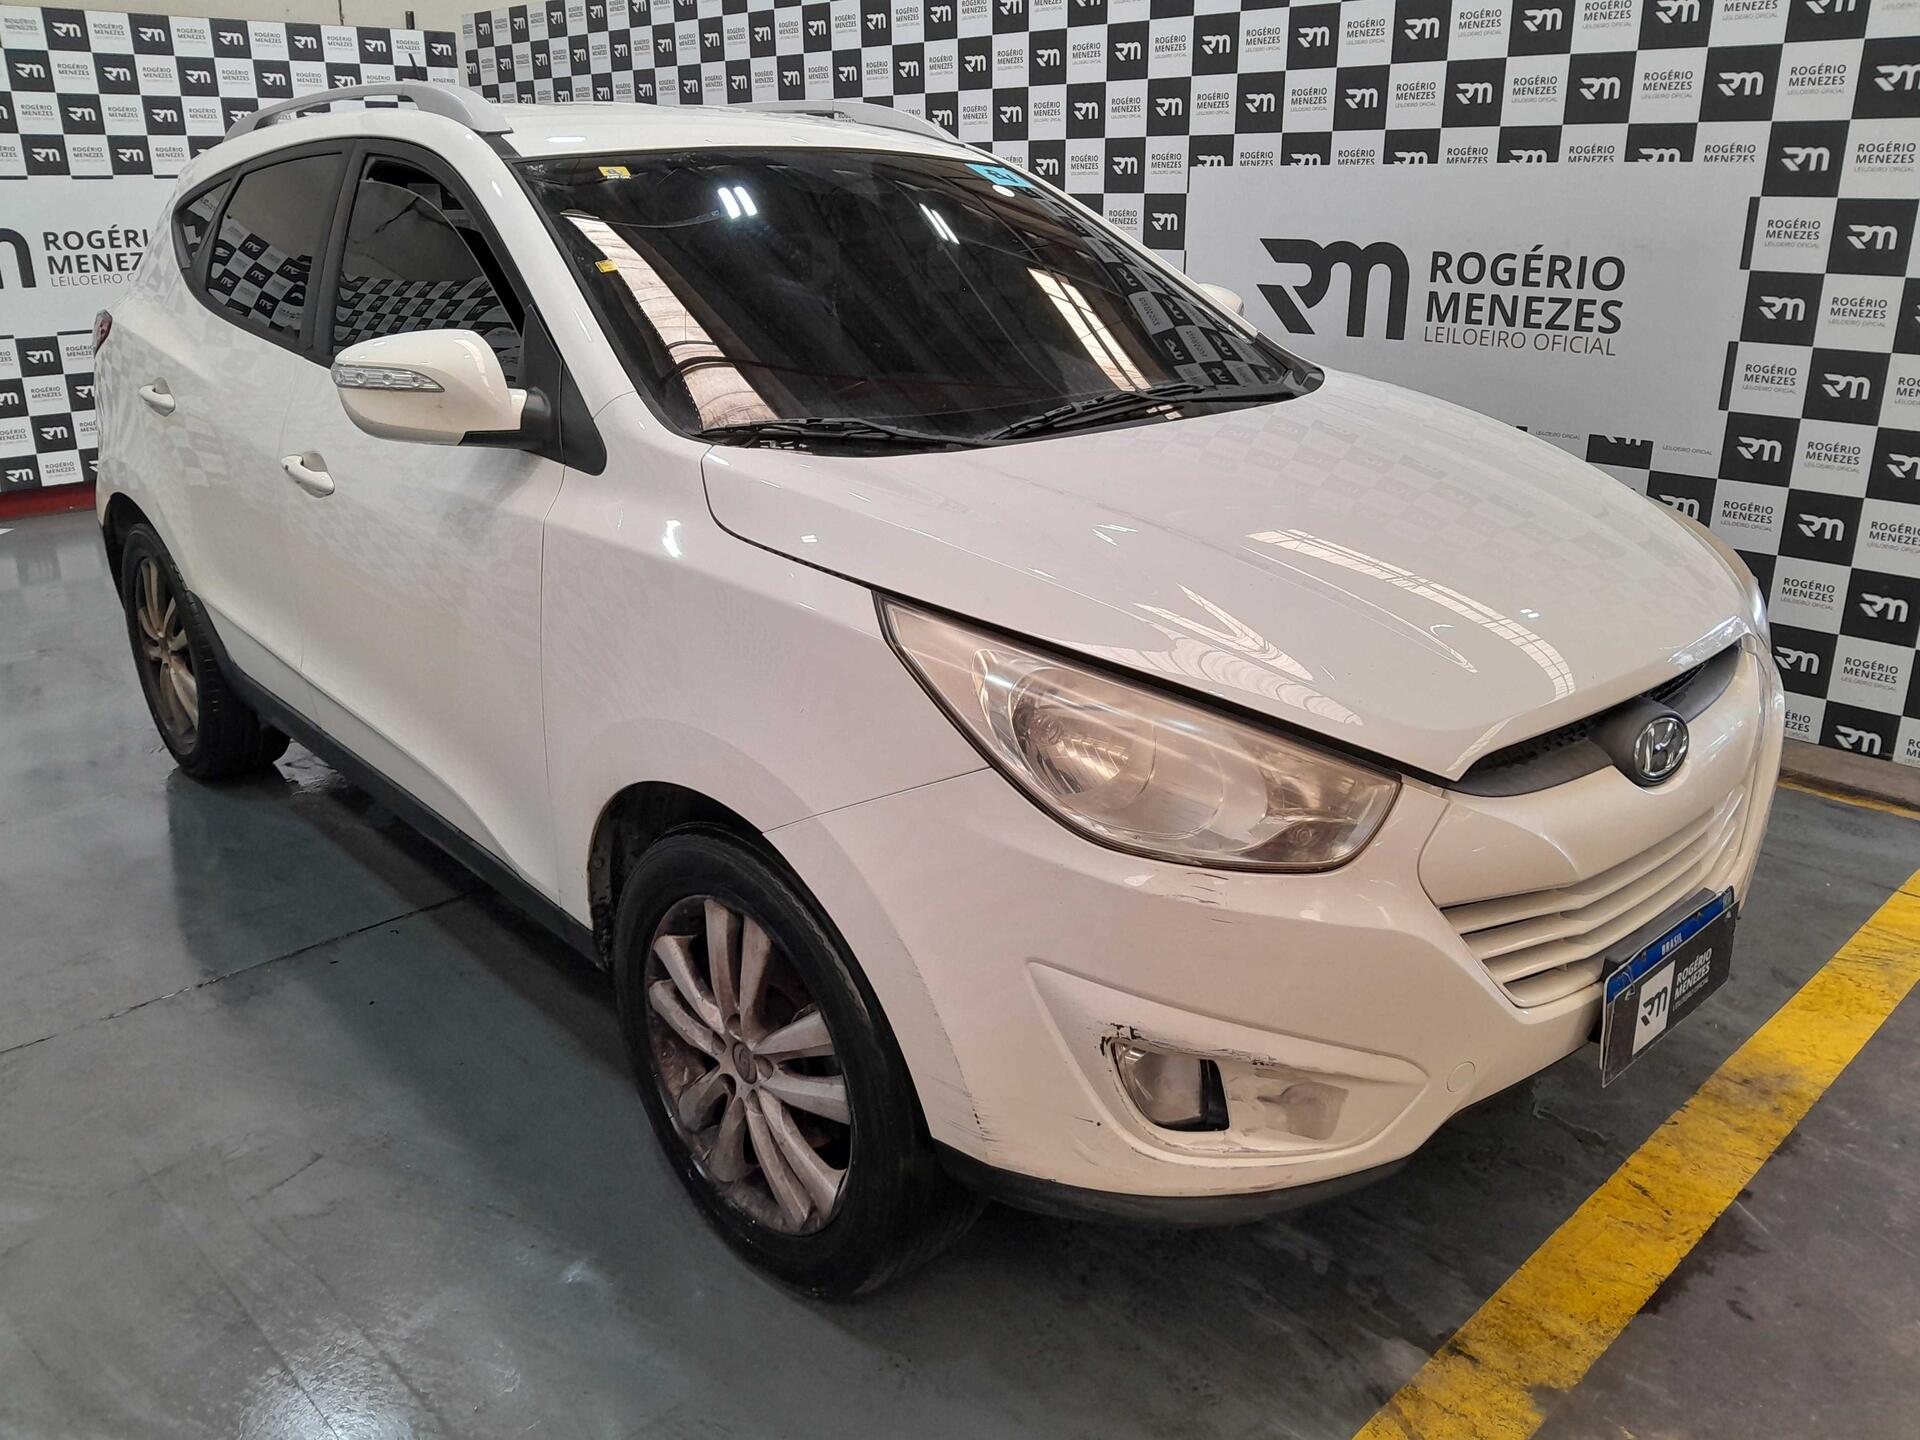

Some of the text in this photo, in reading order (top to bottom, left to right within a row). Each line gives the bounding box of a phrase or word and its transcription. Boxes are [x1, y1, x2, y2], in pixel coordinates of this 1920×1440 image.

[896, 7, 918, 15] ROGÉRIO
[962, 6, 987, 14] MENEZES
[1724, 0, 1778, 12] MENEZES
[835, 14, 856, 22] ROGÉRIO
[896, 14, 919, 22] MENEZES
[1460, 9, 1502, 20] ROGÉRIO
[1584, 10, 1631, 21] MENEZES
[1347, 18, 1385, 29] ROGÉRIO
[1459, 19, 1501, 30] MENEZES
[1246, 27, 1280, 37] ROGÉRIO
[1347, 28, 1384, 38] MENEZES
[1155, 35, 1186, 44] ROGÉRIO
[1246, 36, 1280, 45] MENEZES
[1073, 42, 1101, 51] ROGÉRIO
[1155, 43, 1186, 52] MENEZES
[998, 49, 1023, 57] ROGÉRIO
[1072, 50, 1101, 58] MENEZES
[929, 55, 953, 63] ROGÉRIO
[929, 62, 953, 70] MENEZES
[1791, 64, 1846, 75] ROGÉRIO
[1644, 70, 1693, 80] ROGÉRIO
[1396, 81, 1436, 91] ROGÉRIO
[1514, 76, 1557, 86] ROGÉRIO
[1643, 81, 1692, 90] MENEZES
[1789, 76, 1845, 86] MENEZES
[1292, 87, 1327, 96] ROGÉRIO
[1396, 91, 1435, 100] MENEZES
[1513, 86, 1556, 95] MENEZES
[1112, 96, 1140, 105] ROGÉRIO
[1197, 92, 1229, 100] ROGÉRIO
[1291, 96, 1327, 105] MENEZES
[1034, 101, 1060, 109] ROGÉRIO
[1197, 101, 1229, 109] MENEZES
[963, 112, 987, 120] MENEZES
[1447, 146, 1488, 156] ROGÉRIO
[1569, 144, 1614, 154] ROGÉRIO
[1705, 143, 1756, 153] ROGÉRIO
[1858, 142, 1916, 152] ROGÉRIO
[1338, 148, 1375, 157] ROGÉRIO
[1071, 154, 1098, 162] ROGÉRIO
[1856, 154, 1914, 163] MENEZES
[1109, 209, 1137, 217] ROGÉRIO
[1768, 219, 1820, 229] ROGÉRIO
[43, 224, 149, 251] ROGÉRI
[1766, 230, 1819, 239] MENEZES
[47, 252, 143, 274] MENEZ
[1429, 244, 1625, 291] ROGÉRIO
[51, 273, 123, 287] LEILOEIRO
[1832, 297, 1887, 308] ROGÉRIO
[1426, 291, 1624, 334] MENEZES
[1830, 308, 1886, 318] MENEZES
[1424, 325, 1616, 356] LEILOEIRO OFICIAL
[1746, 364, 1797, 376] ROGÉRIO
[1744, 374, 1796, 386] MENEZES
[1808, 441, 1860, 455] ROGÉRIO
[1806, 451, 1859, 464] MENEZES
[1724, 501, 1773, 514] ROGÉRIO
[1722, 510, 1772, 524] MENEZES
[1784, 578, 1835, 593] ROGÉRIO
[1782, 587, 1834, 602] MENEZES
[1845, 657, 1898, 674] ROGÉRIO
[1843, 666, 1896, 684] MENEZES
[1785, 710, 1810, 723] ÉRIO
[1785, 721, 1809, 732] EZES
[1661, 933, 1683, 956] BRASIL
[1677, 948, 1712, 986] ROGÉRIO
[1675, 961, 1711, 1000] MENEZES
